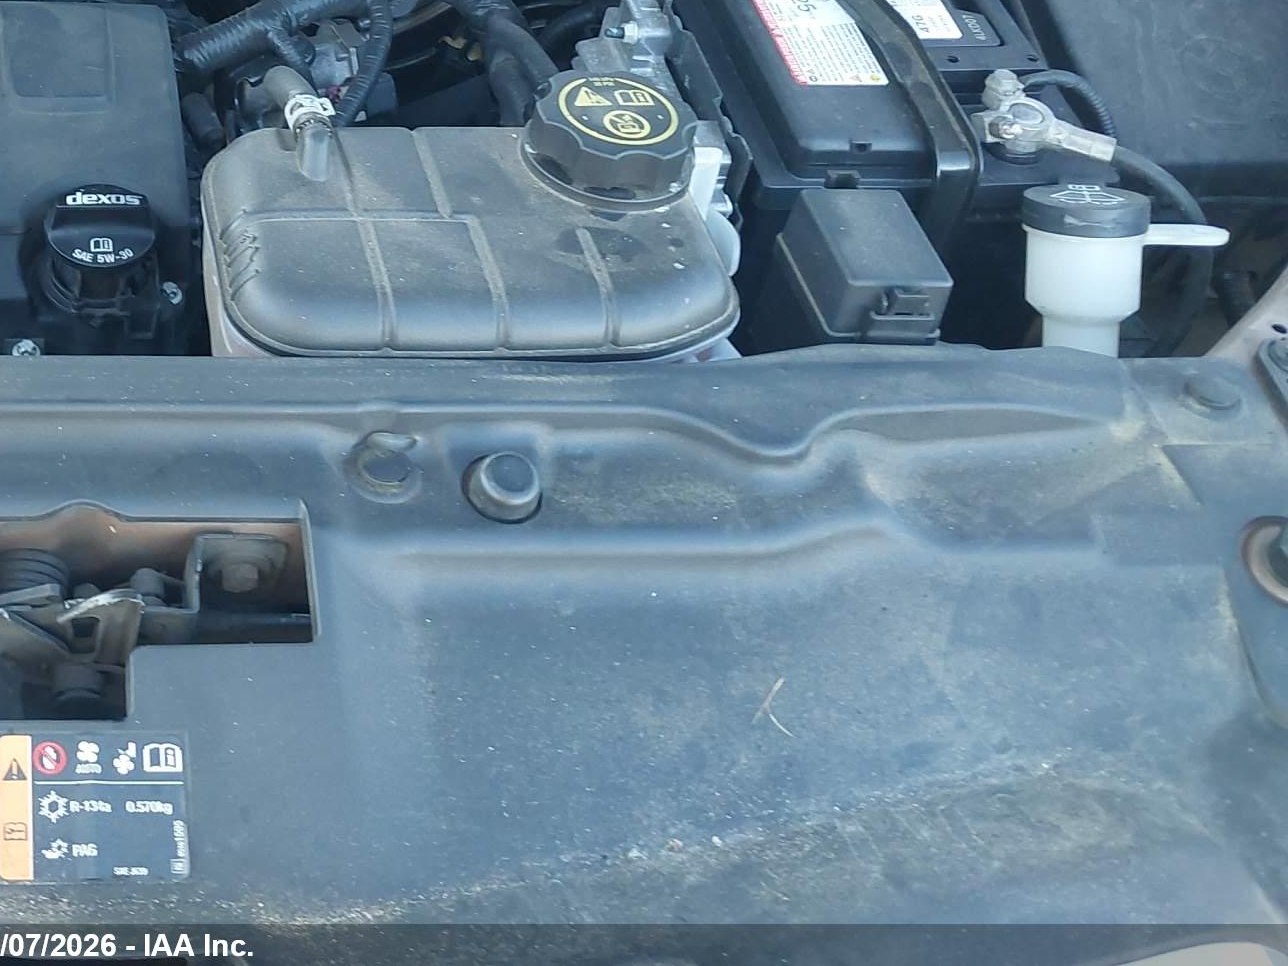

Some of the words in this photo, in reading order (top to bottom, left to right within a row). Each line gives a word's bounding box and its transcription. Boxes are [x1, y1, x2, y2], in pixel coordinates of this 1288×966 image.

[65, 191, 144, 206] dexos
[72, 248, 94, 263] SAE
[96, 248, 134, 263] 5W-30
[69, 800, 112, 813] R-134a
